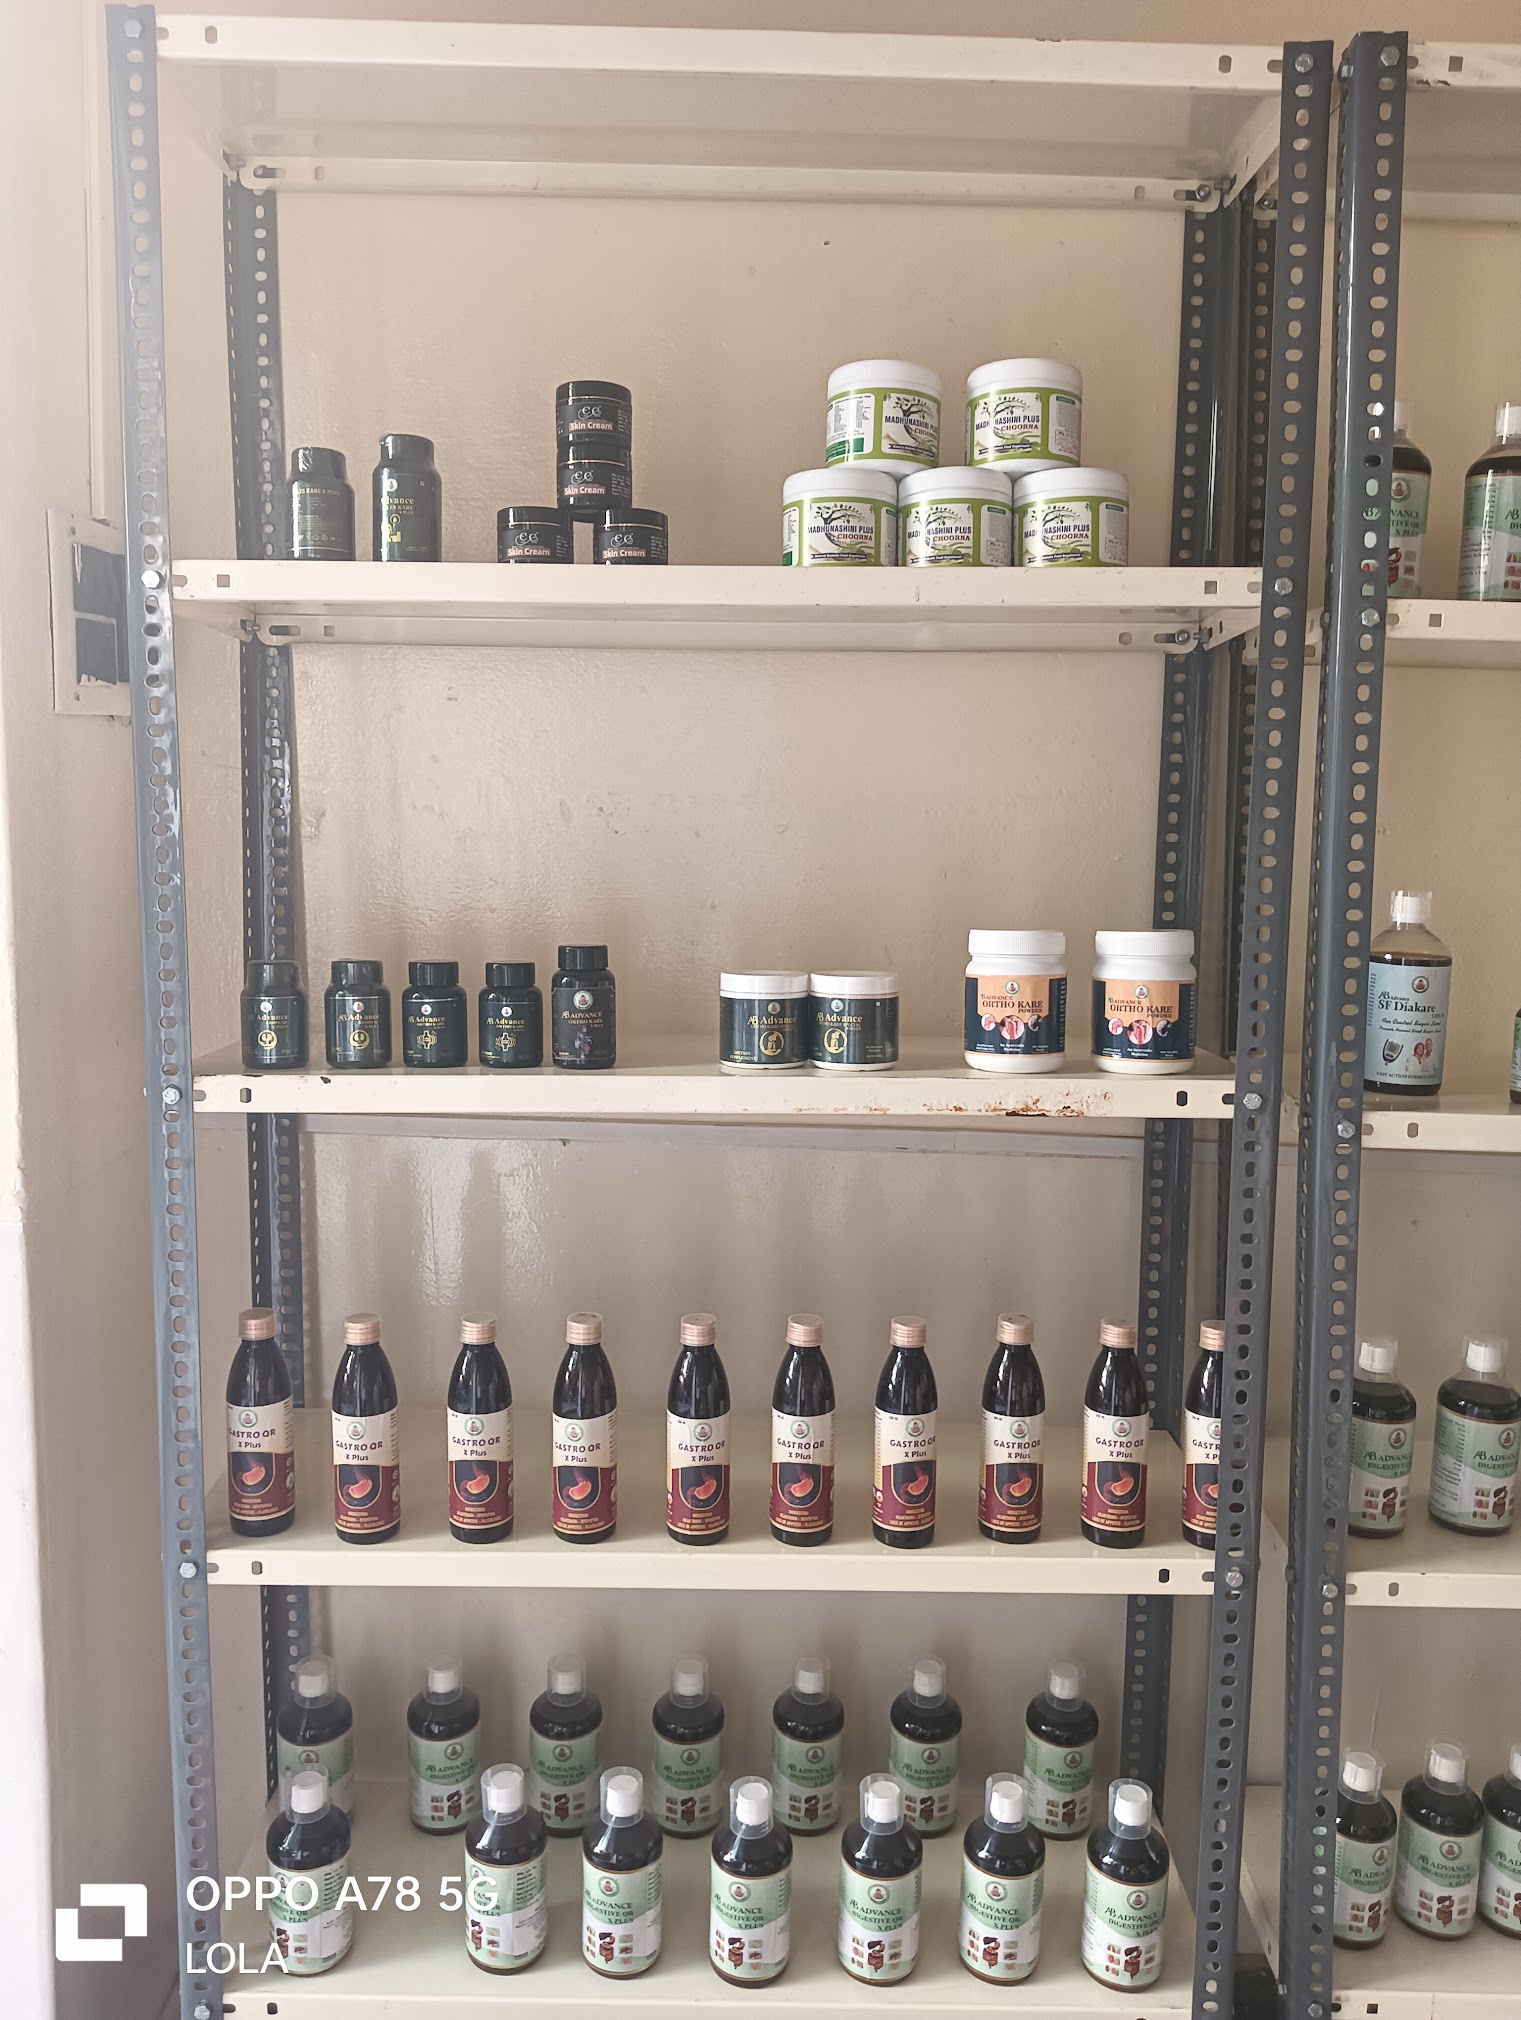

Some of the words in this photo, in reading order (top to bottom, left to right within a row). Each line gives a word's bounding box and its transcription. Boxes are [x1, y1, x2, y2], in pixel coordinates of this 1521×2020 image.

[570, 422, 586, 430] Skin
[588, 422, 613, 430] Cream
[885, 415, 929, 430] MADHUNASHINI
[976, 415, 1021, 431] MADHNASHINI
[1023, 414, 1040, 423] PLUS
[1001, 424, 1039, 432] CHOORNA
[564, 487, 578, 495] Skin
[580, 486, 605, 494] Cream
[1505, 509, 1519, 520] AB
[858, 525, 874, 534] PLUS
[955, 526, 972, 535] PLUS
[1073, 524, 1090, 532] PLUS
[508, 548, 523, 556] Skin
[524, 548, 550, 556] Cream
[603, 550, 618, 558] Skin
[1378, 991, 1390, 1000] AB
[982, 1000, 1014, 1008] ORTHO
[1110, 1004, 1144, 1013] ORTHO
[1378, 1000, 1392, 1010] SF
[1394, 1001, 1436, 1012] Diakare
[562, 1011, 570, 1019] AB
[825, 1014, 863, 1022] Advance
[747, 1016, 759, 1025] AB
[760, 1016, 797, 1024] Advance
[262, 1428, 276, 1437] QR
[336, 1440, 367, 1451] GASTRO
[370, 1441, 383, 1450] QR
[452, 1436, 485, 1446] GASTRO
[488, 1436, 500, 1445] QR
[777, 1438, 811, 1450] GASTRO
[812, 1441, 824, 1449] QR
[890, 1439, 926, 1448] GASTRO
[994, 1439, 1030, 1449] GASTRO
[1096, 1437, 1132, 1448] GASTRO
[1192, 1440, 1220, 1451] GASTR
[555, 1442, 586, 1452] GASTRO
[588, 1443, 601, 1452] QR
[678, 1443, 713, 1452] GASTRO
[1364, 1451, 1377, 1460] AB
[1473, 1451, 1486, 1460] AB
[1495, 1850, 1507, 1862] AB
[1418, 1854, 1429, 1865] AB
[1431, 1861, 1470, 1872] ADVANCE
[1350, 1868, 1362, 1877] AB
[1421, 1866, 1461, 1880] DIGESTIVE
[592, 1897, 632, 1909] ADVANCE
[722, 1902, 763, 1914] ADVANCE
[850, 1899, 859, 1910] AB
[860, 1906, 902, 1916] ADVANCE
[967, 1891, 977, 1904] AB
[977, 1901, 1019, 1915] ADVANCE
[586, 1902, 621, 1917] DIGESTIVE
[716, 1905, 751, 1922] DIGESTIVE
[970, 1904, 1007, 1922] DIGESTIVE
[1105, 1907, 1116, 1917] AB
[1118, 1912, 1157, 1921] ADVANCE
[852, 1910, 890, 1923] DIGESTIVE
[1109, 1918, 1147, 1929] DIGESTIVE
